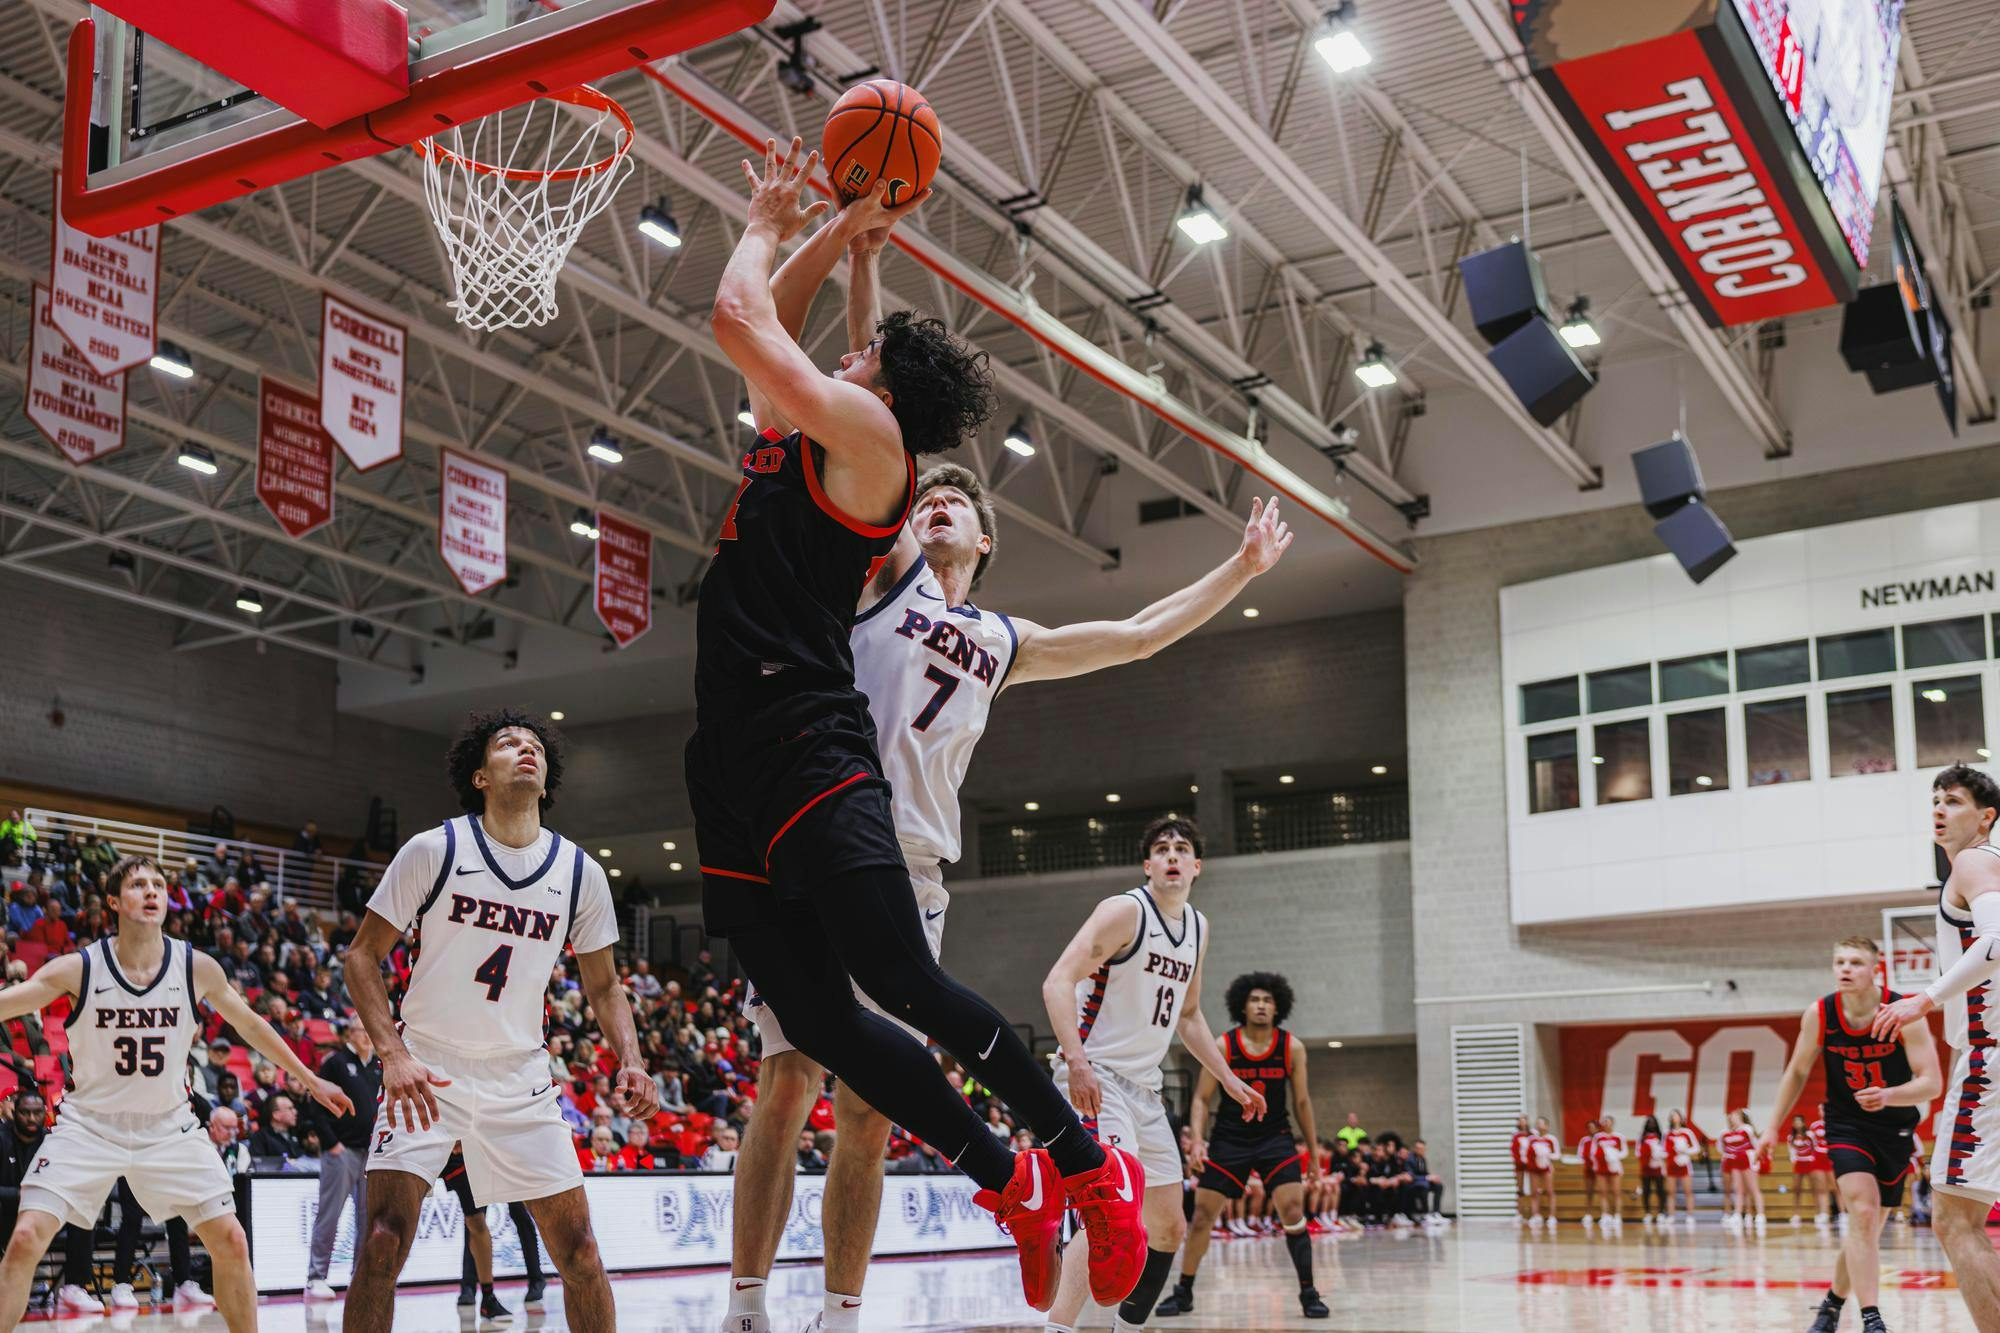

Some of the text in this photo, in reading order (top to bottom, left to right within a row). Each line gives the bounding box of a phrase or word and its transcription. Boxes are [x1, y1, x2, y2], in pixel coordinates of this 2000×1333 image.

[1604, 76, 1808, 298] CORNELL
[63, 247, 147, 295] BASKETBALL
[87, 240, 129, 269] MEN'S
[55, 287, 98, 321] SWEET
[88, 279, 124, 310] NCAA
[330, 308, 399, 356] CORNELL
[33, 388, 119, 434] TOURNAMENT
[61, 380, 96, 408] NCAA
[264, 392, 321, 431] CORNEL
[1861, 569, 1995, 609] NEWMAN
[894, 607, 1000, 689] PENN
[910, 663, 960, 733] 7
[448, 893, 560, 942] PENN
[474, 943, 514, 1002] 4
[1144, 952, 1192, 983] PENN
[95, 1007, 180, 1029] PENN
[1152, 985, 1174, 1028] 13
[113, 1036, 166, 1077] 35
[1844, 1061, 1887, 1090] 31
[1600, 1025, 1789, 1140] GO
[374, 1130, 394, 1154] P
[32, 1157, 50, 1174] P
